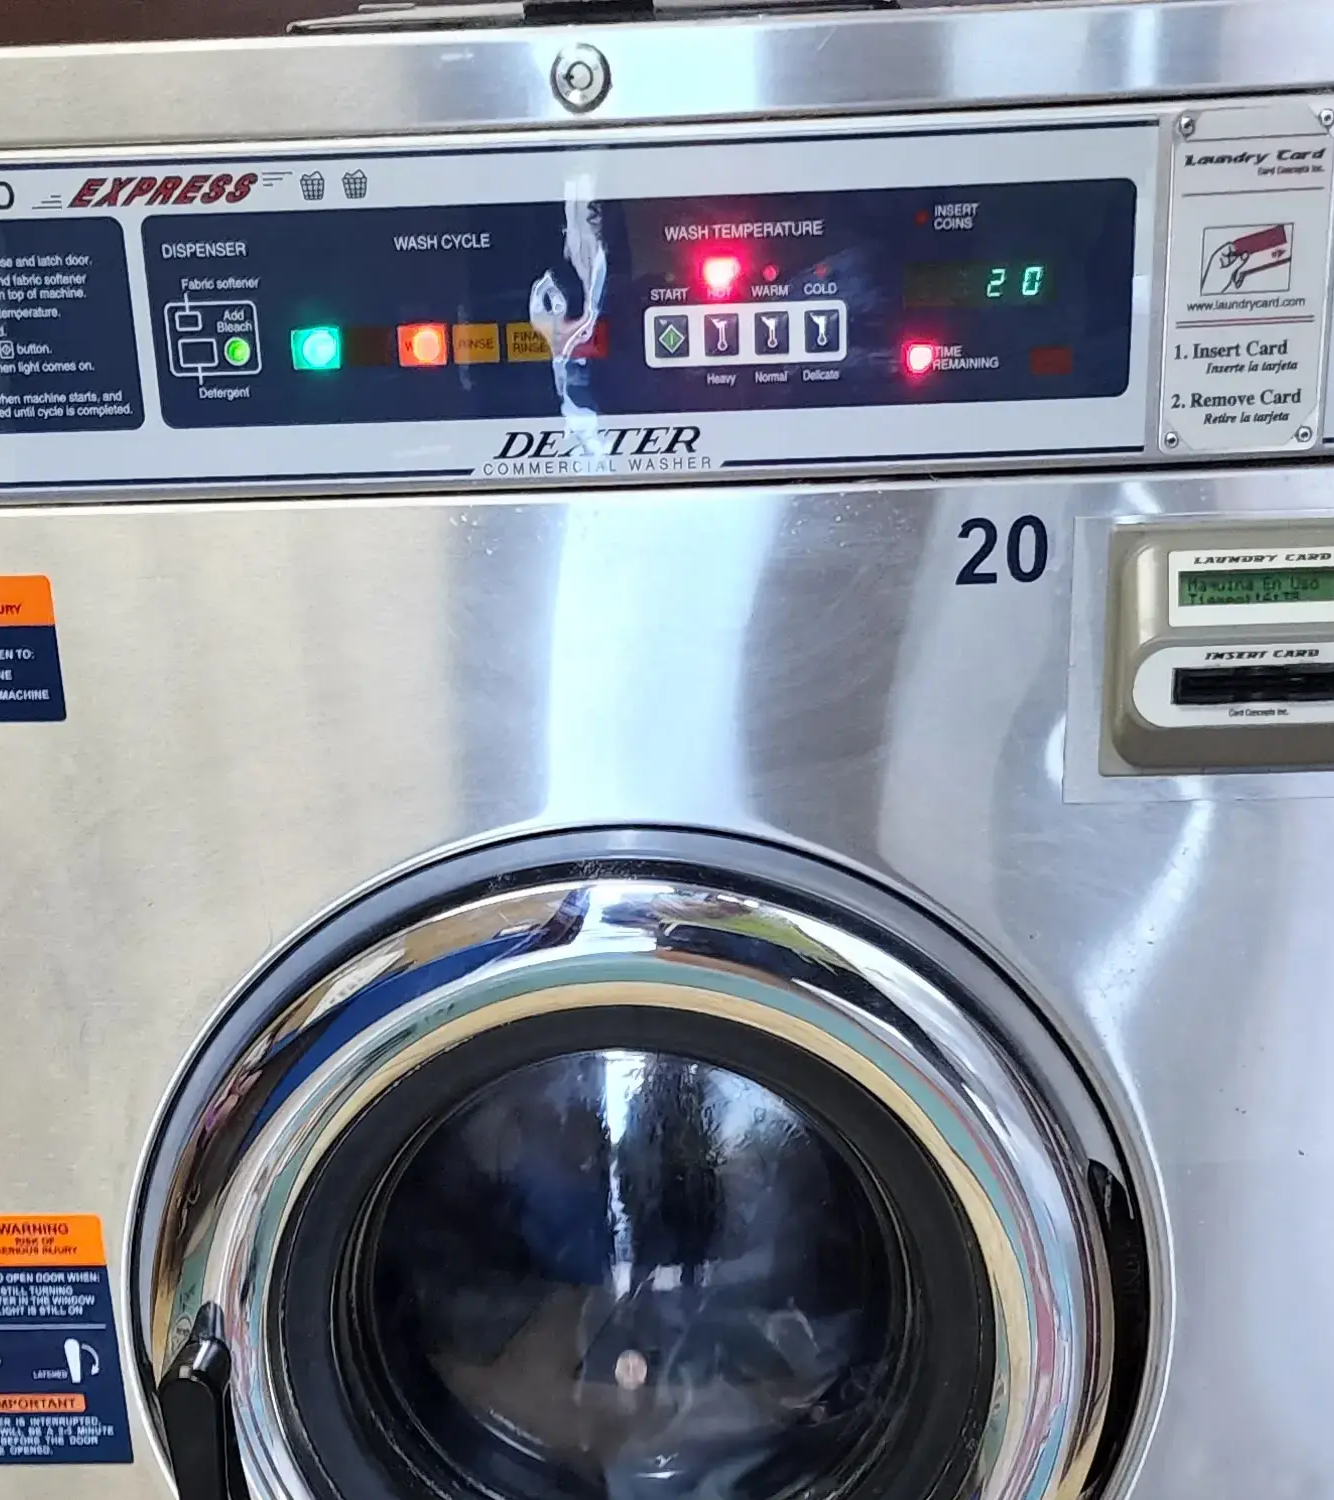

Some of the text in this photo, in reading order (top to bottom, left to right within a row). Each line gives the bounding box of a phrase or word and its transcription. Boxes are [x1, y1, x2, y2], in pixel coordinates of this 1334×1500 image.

[1184, 148, 1326, 166] Laundry Card
[67, 172, 258, 207] EXPRESS
[934, 203, 978, 218] INSERT
[933, 216, 973, 230] COINS
[665, 220, 824, 241] WASH TEMPERATURE
[394, 233, 491, 251] WASH CYCLE
[162, 242, 246, 259] DISPENSER
[15, 256, 35, 267] and
[180, 276, 260, 291] Fabric softener
[987, 266, 1043, 297] 20
[651, 282, 837, 301] START WARM COLD
[1187, 298, 1305, 312] www.laundrycard.com
[223, 310, 244, 321] Add
[217, 320, 253, 333] Bleach
[935, 345, 962, 359] TIME
[1175, 340, 1288, 360] 1. Insert Card
[18, 362, 40, 375] light
[42, 362, 76, 372] comes
[932, 357, 999, 371] REMAINING
[1205, 361, 1298, 374] Inserte la tarjeta
[707, 369, 839, 386] Heavy Normal Delicate
[199, 386, 251, 400] Detergent
[1171, 388, 1301, 409] 2. Remove Card
[1203, 411, 1290, 425] Retire la tarjeta
[483, 456, 711, 475] COMMERCIAL WASHER
[955, 514, 1049, 585] 20
[1194, 551, 1332, 565] LAUNDRY CARD
[1205, 649, 1319, 660] INSERT CARD
[0, 689, 50, 700] MACHINE
